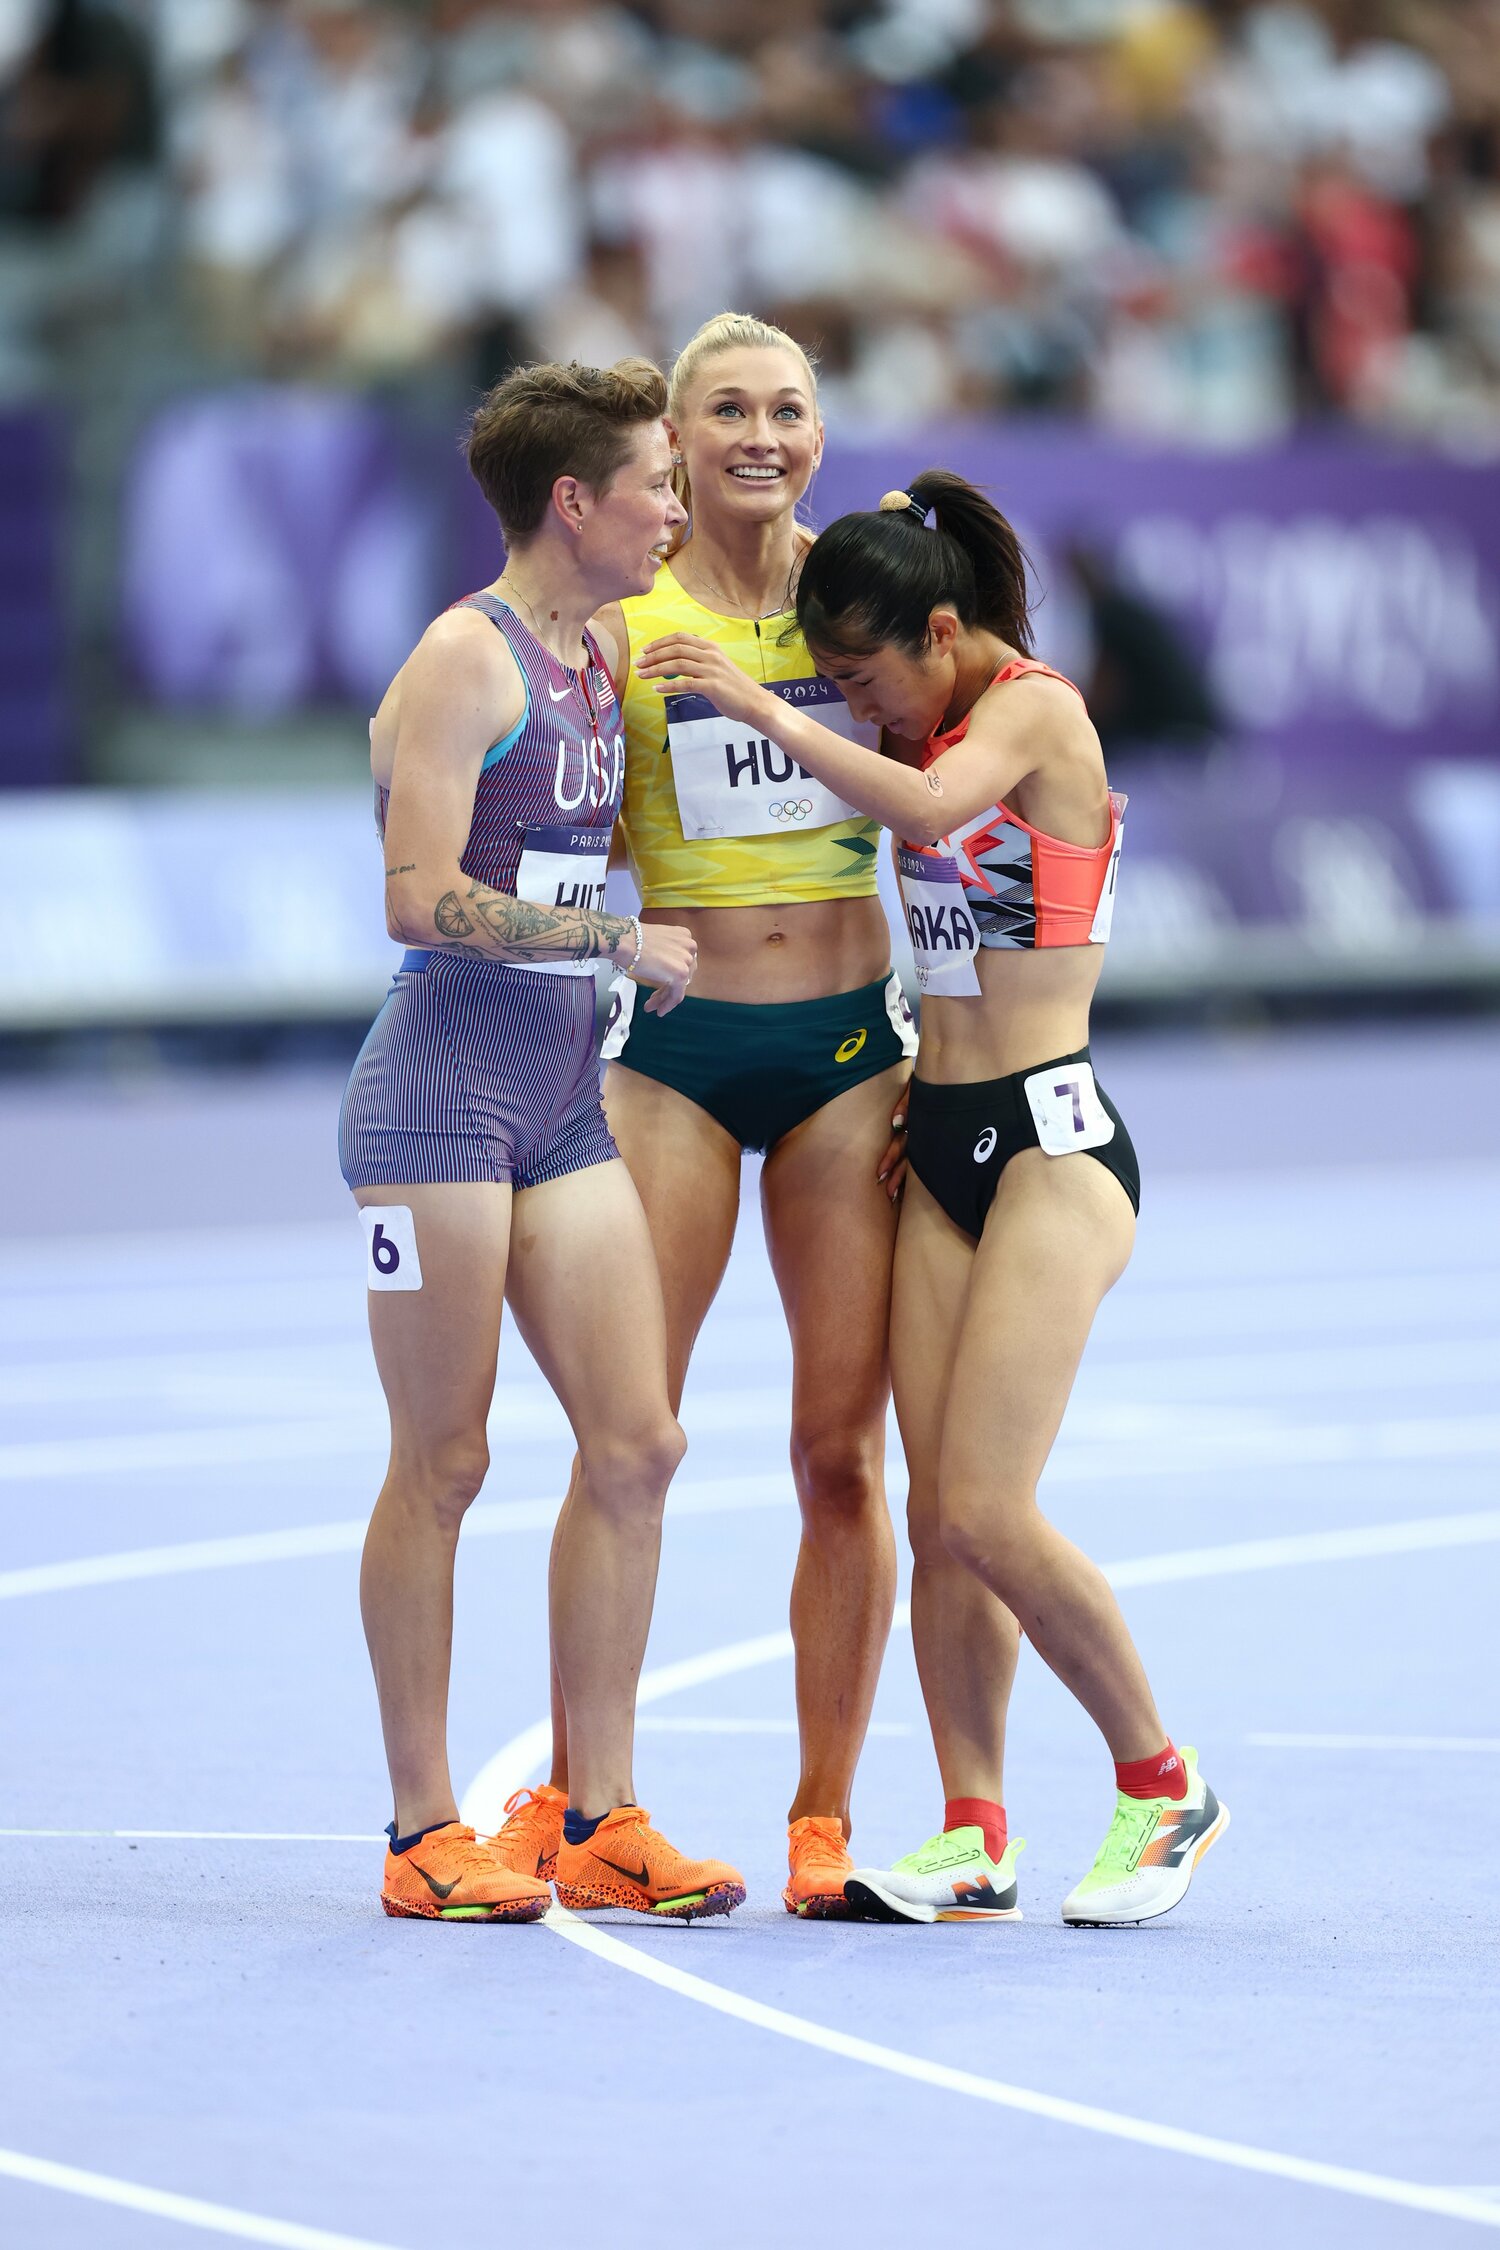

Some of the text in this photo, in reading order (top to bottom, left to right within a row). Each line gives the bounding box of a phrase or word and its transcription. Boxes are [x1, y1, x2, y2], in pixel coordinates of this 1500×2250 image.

[783, 683, 828, 700] 2024
[555, 734, 626, 811] USA
[570, 834, 600, 848] PARIS
[907, 857, 926, 874] 2024
[906, 902, 975, 951] AKA
[1053, 1081, 1085, 1133] 7
[372, 1223, 400, 1275] 6
